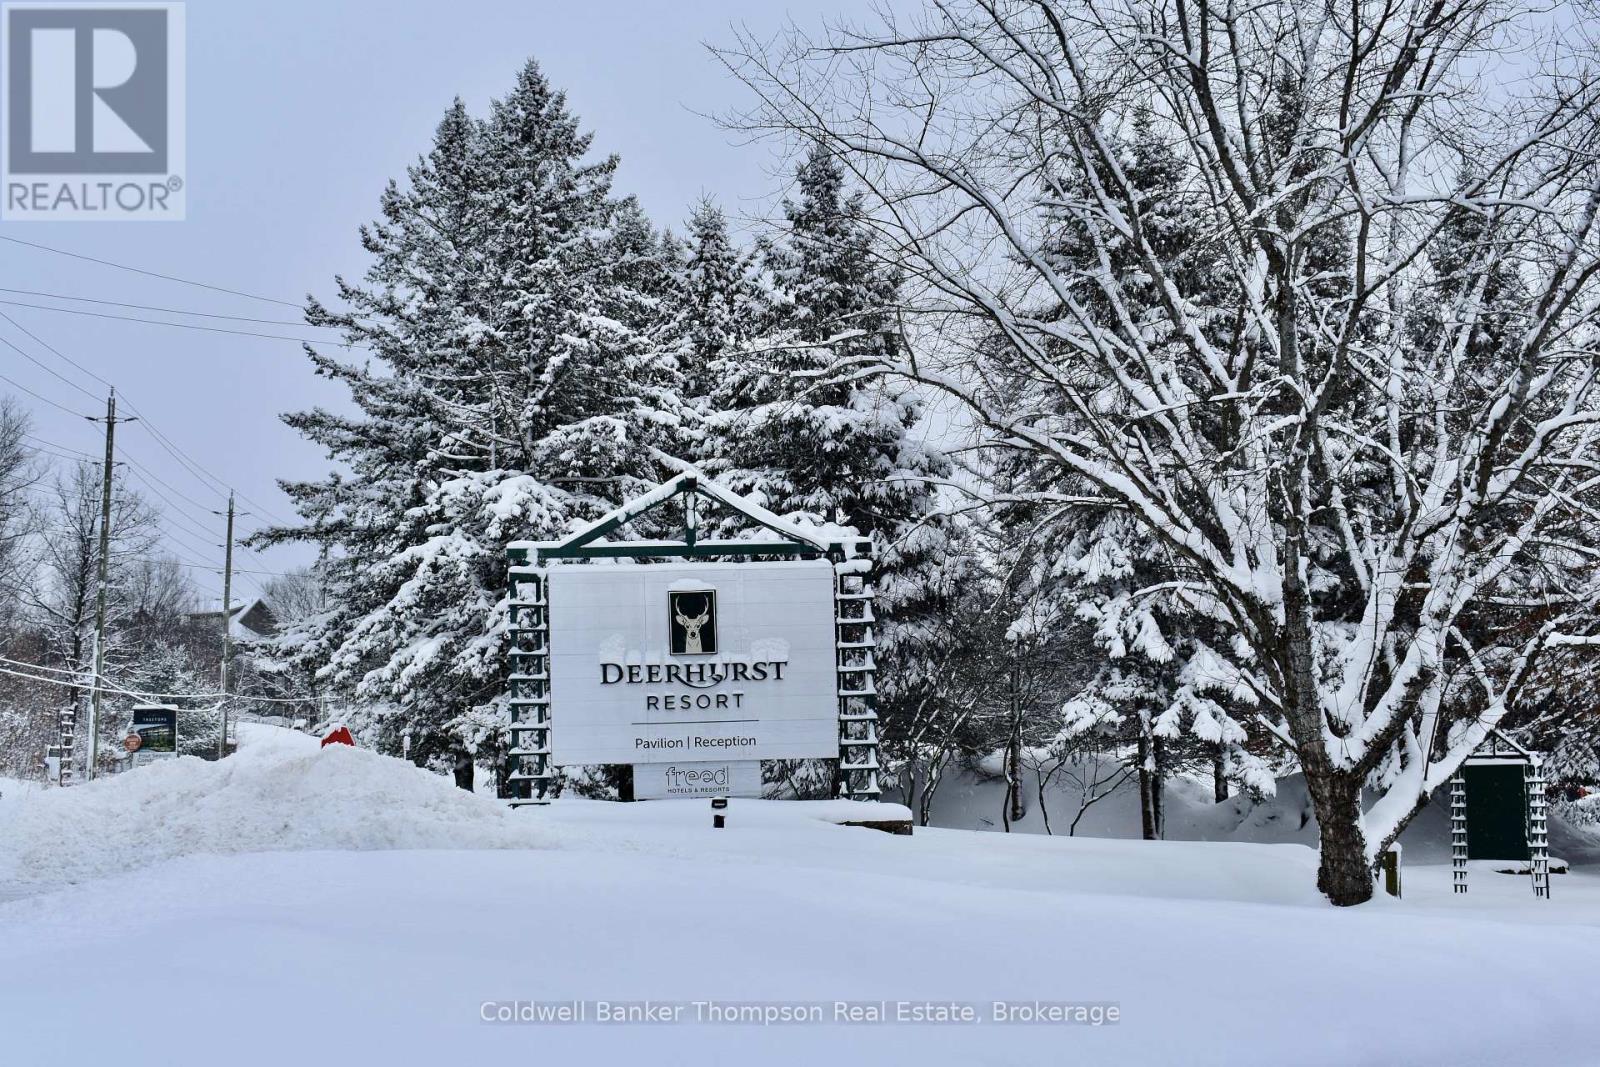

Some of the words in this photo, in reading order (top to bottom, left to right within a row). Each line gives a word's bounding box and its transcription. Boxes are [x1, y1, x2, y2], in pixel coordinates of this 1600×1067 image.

[600, 661, 788, 688] DEERHURST
[646, 693, 744, 710] RESORT
[635, 737, 683, 749] Pavilion
[694, 735, 757, 749] Reception
[665, 765, 729, 786] freed
